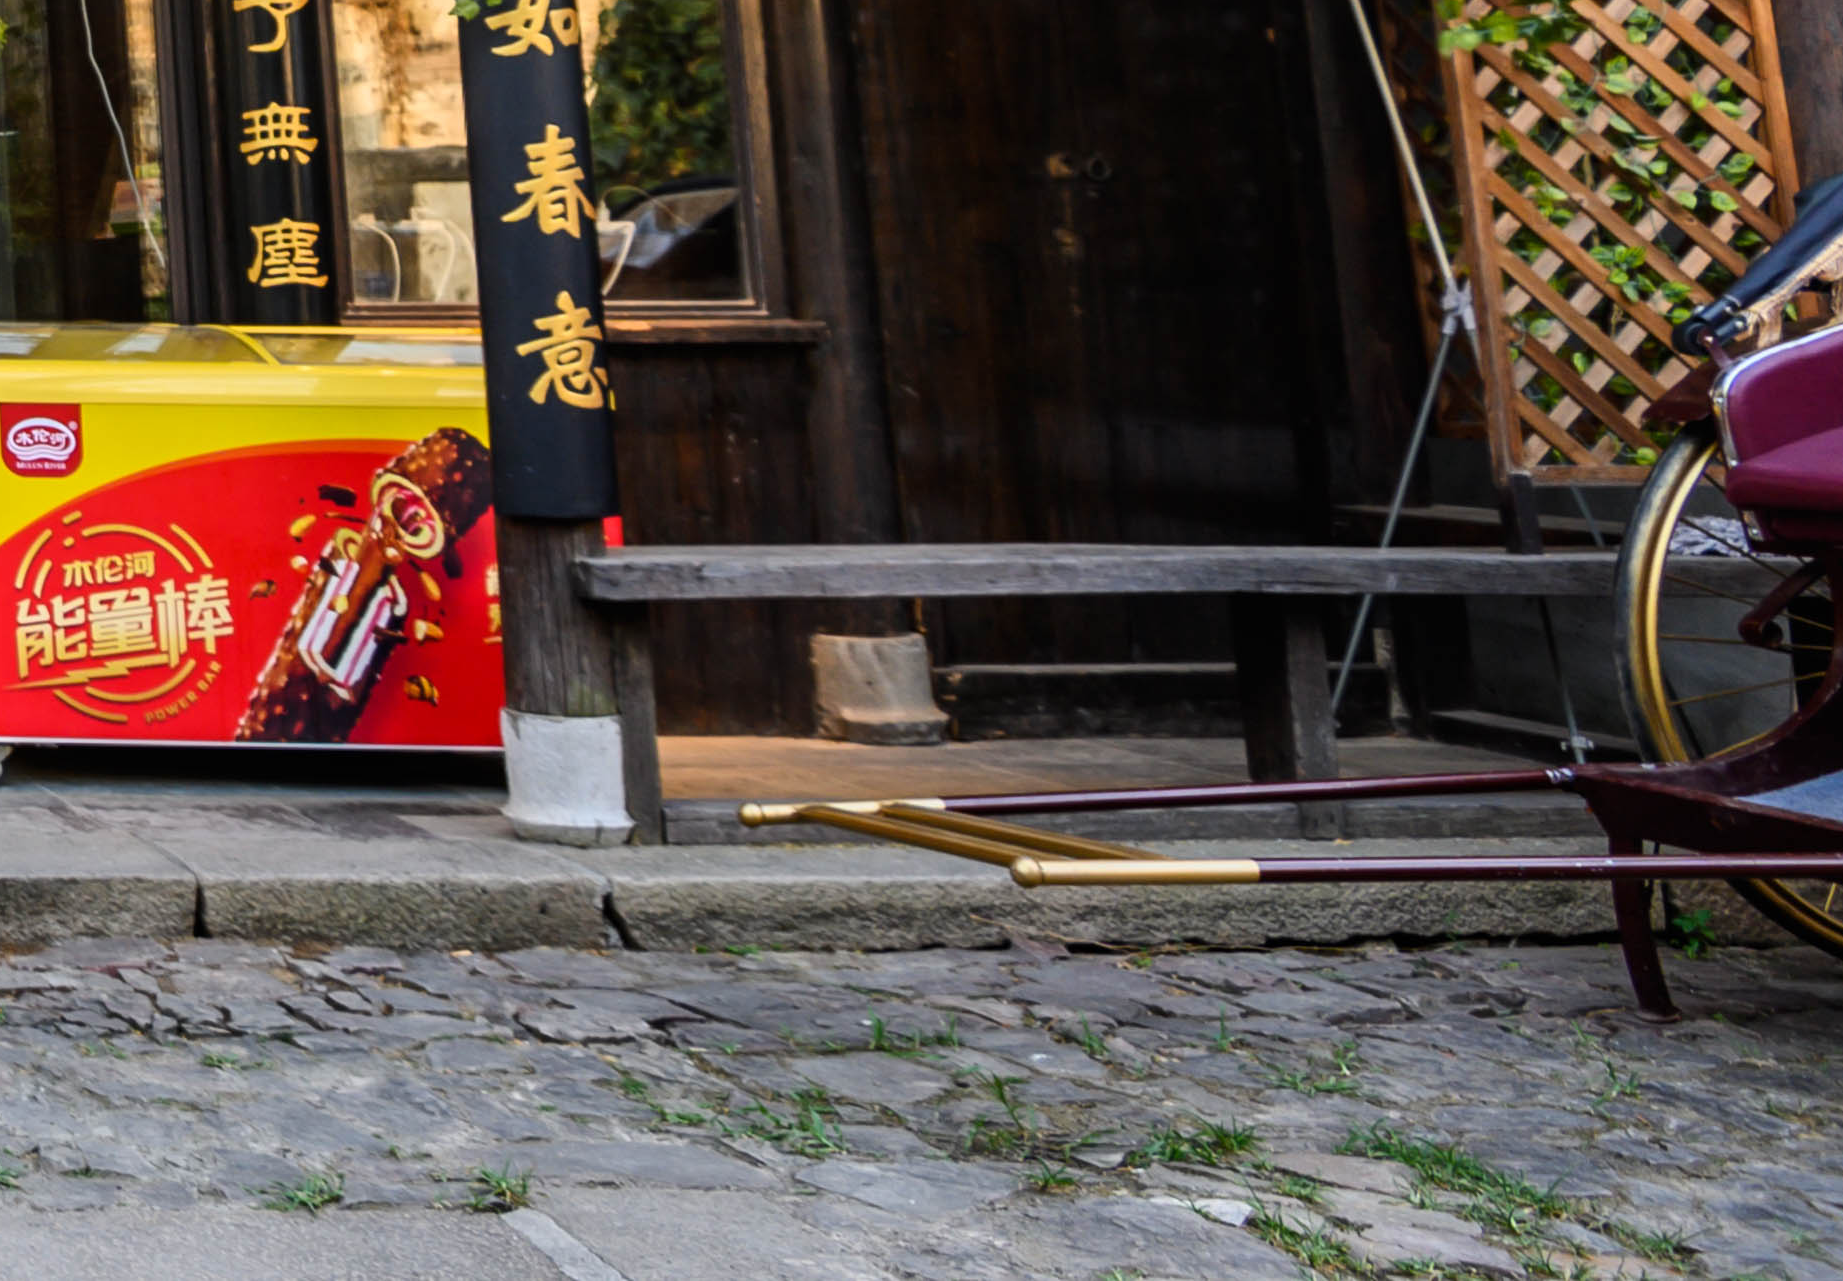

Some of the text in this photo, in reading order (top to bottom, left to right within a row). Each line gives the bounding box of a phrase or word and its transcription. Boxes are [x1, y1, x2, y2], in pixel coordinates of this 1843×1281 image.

[62, 550, 155, 588] 木伦河
[16, 573, 234, 680] 能量棒
[145, 660, 222, 724] POWER BAR
